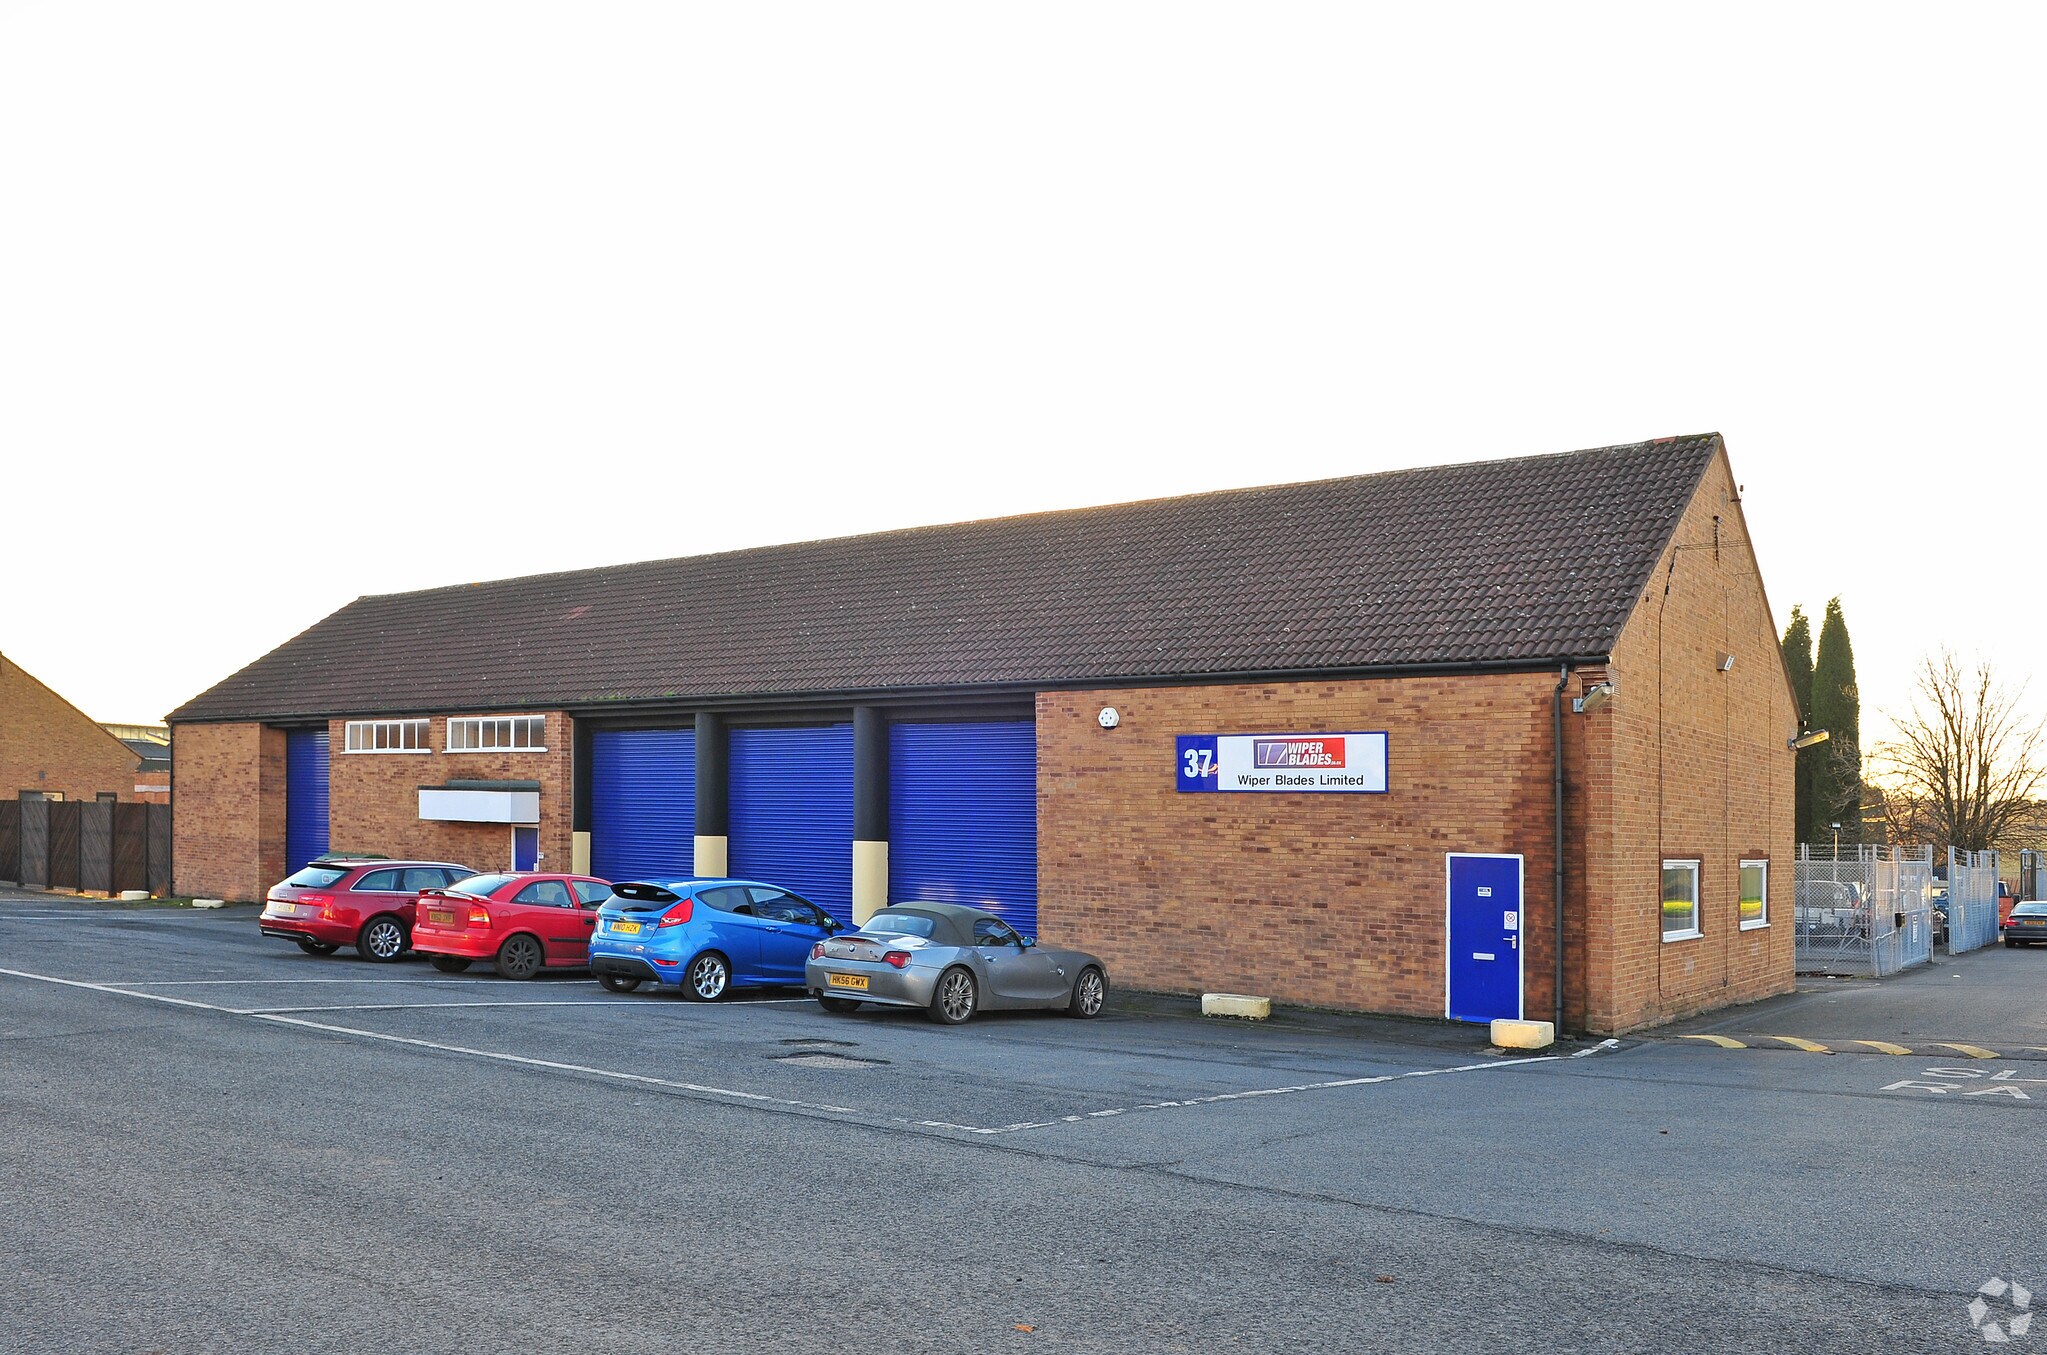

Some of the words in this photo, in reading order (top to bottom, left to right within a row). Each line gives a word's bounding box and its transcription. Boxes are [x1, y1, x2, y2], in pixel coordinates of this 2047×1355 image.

[1288, 742, 1324, 754] WIPER
[1184, 749, 1212, 778] 37
[1289, 753, 1332, 766] BLADES
[1238, 775, 1270, 787] Wiper
[1275, 775, 1315, 786] Blades
[1320, 775, 1364, 786] Limited
[832, 975, 850, 985] HK56
[851, 977, 866, 987] GWX
